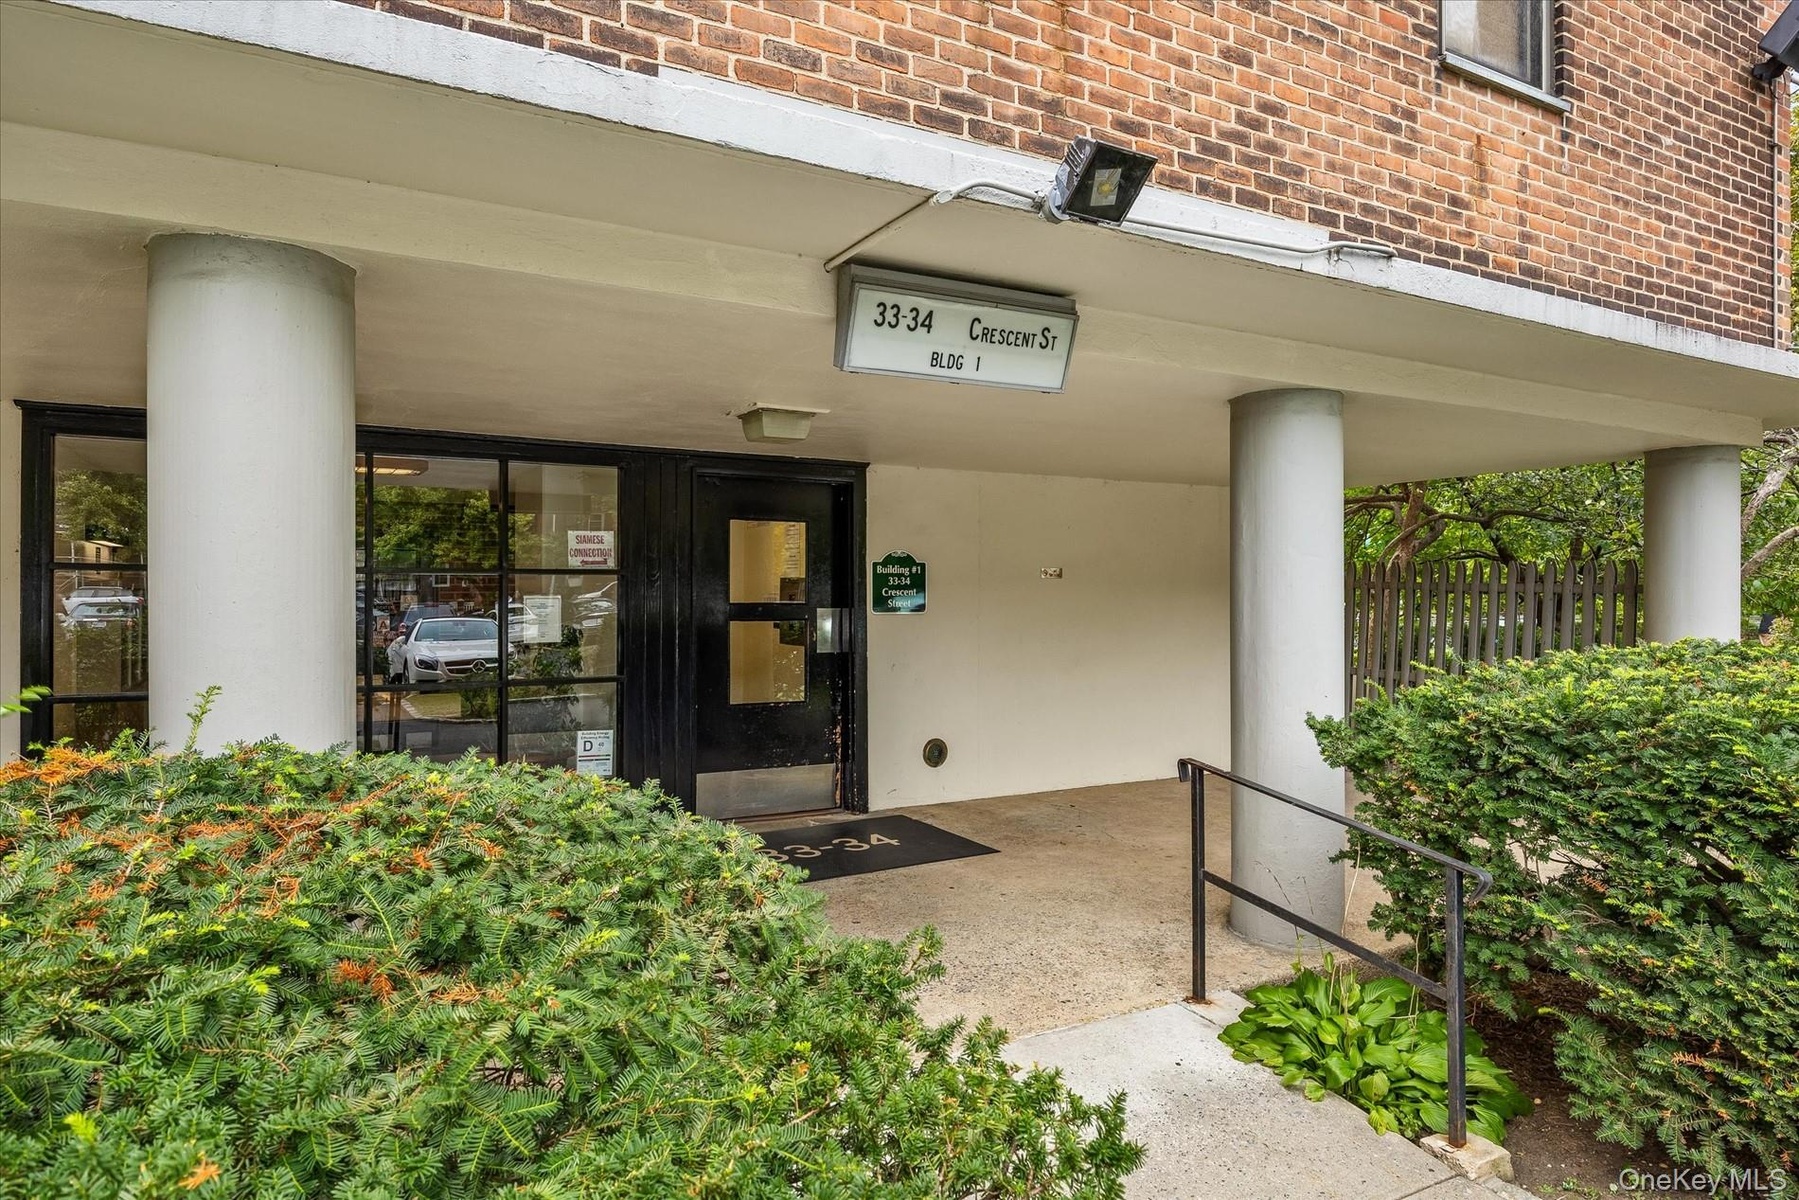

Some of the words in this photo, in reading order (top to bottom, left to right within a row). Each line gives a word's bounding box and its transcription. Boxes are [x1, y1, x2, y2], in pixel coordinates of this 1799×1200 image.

[873, 302, 934, 334] 33-34
[969, 317, 1037, 349] CRESCENT
[930, 351, 964, 370] BLDG
[575, 534, 605, 544] SIAMESE
[569, 548, 612, 557] CONNECTION
[876, 565, 910, 576] Building
[911, 566, 921, 574] #1
[887, 577, 911, 585] 33-34
[882, 588, 917, 597] Crescent
[887, 599, 911, 608] Street
[583, 740, 593, 752] D
